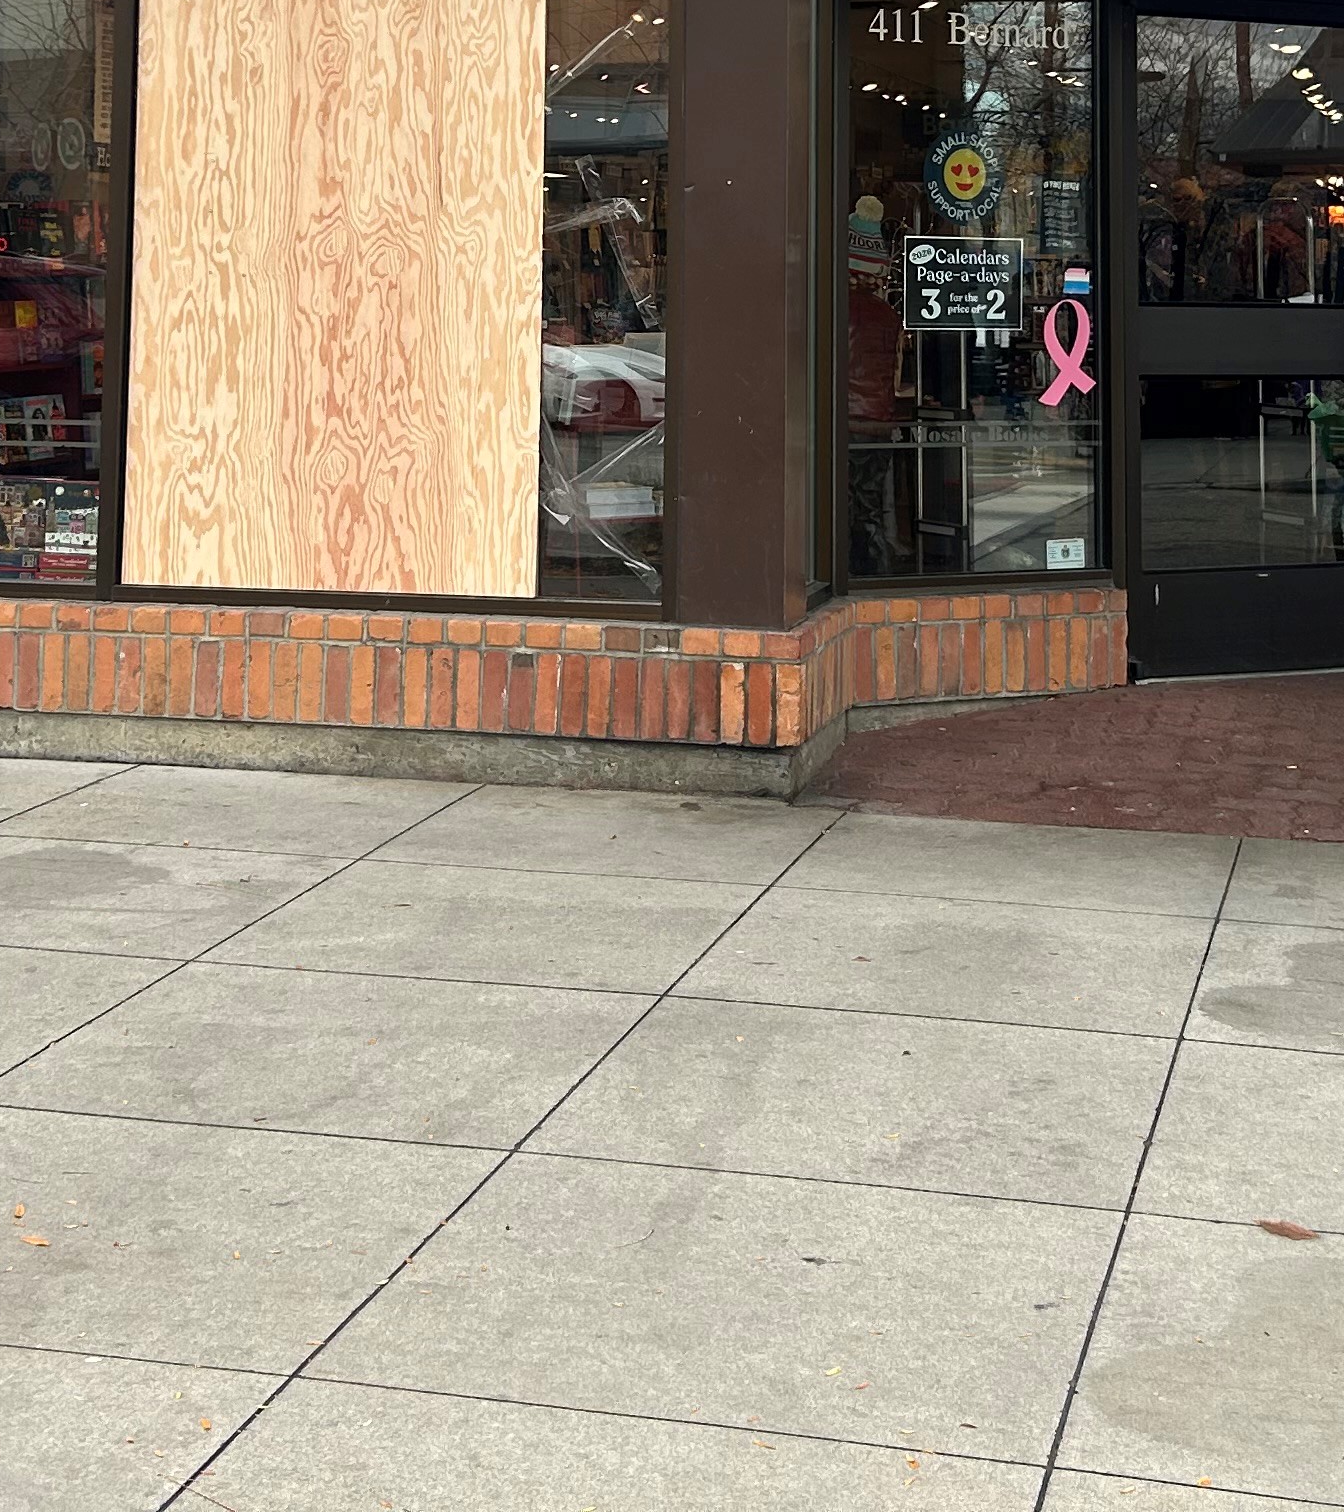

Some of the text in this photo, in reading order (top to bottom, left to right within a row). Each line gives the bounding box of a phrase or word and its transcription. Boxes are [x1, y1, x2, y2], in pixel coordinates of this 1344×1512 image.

[868, 8, 1070, 49] 411 Bernard
[932, 132, 998, 167] SMALL SHOP
[928, 180, 970, 221] SUPPORT
[972, 186, 1002, 219] LOCAL
[936, 248, 1010, 265] Calendars
[917, 266, 1010, 286] Page-a-days
[921, 289, 941, 319] 3
[947, 304, 969, 315] price
[949, 292, 978, 302] for the
[986, 289, 1006, 319] 2
